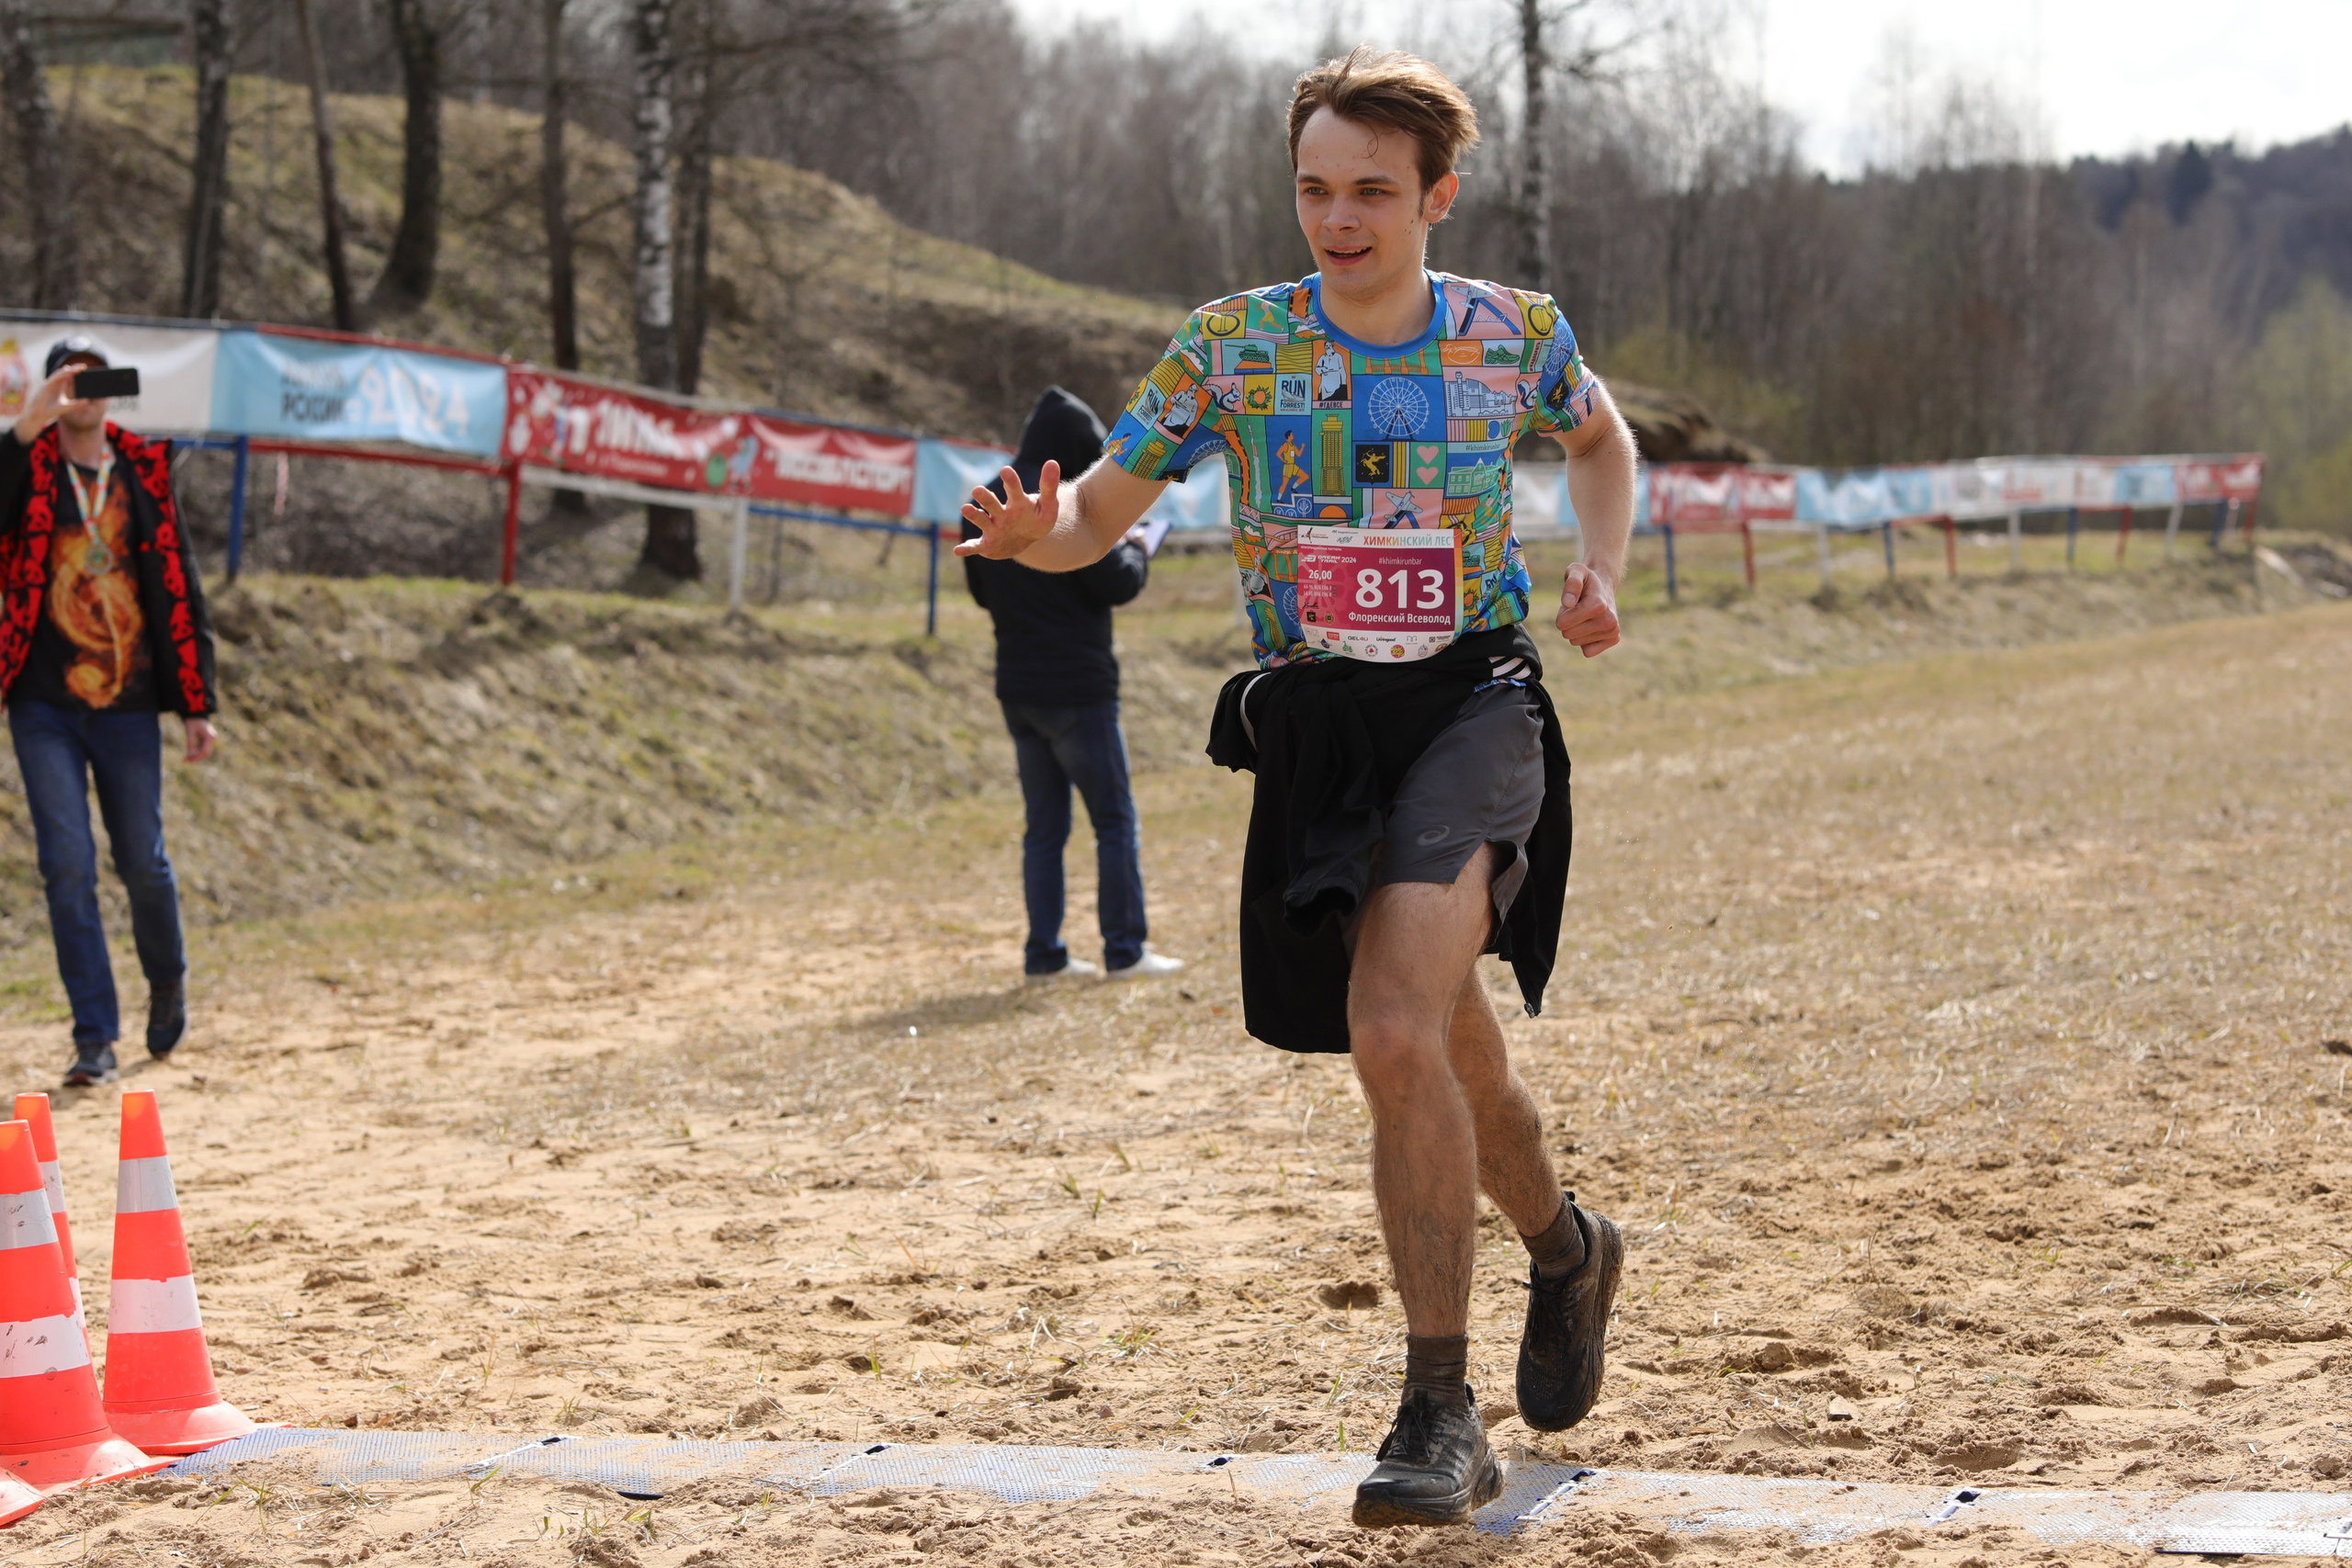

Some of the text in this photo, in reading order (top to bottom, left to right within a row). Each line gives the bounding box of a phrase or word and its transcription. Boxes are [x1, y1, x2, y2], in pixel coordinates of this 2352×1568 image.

[1282, 379, 1306, 400] RUN
[1363, 534, 1432, 547] ХИМКИНСКИЙ
[1434, 536, 1452, 546] ЛЕС
[1378, 557, 1422, 565] #khimkirunbar
[1308, 570, 1332, 581] 26,00
[1355, 568, 1444, 609] 813
[1348, 612, 1451, 626] Флоренский Всеволод
